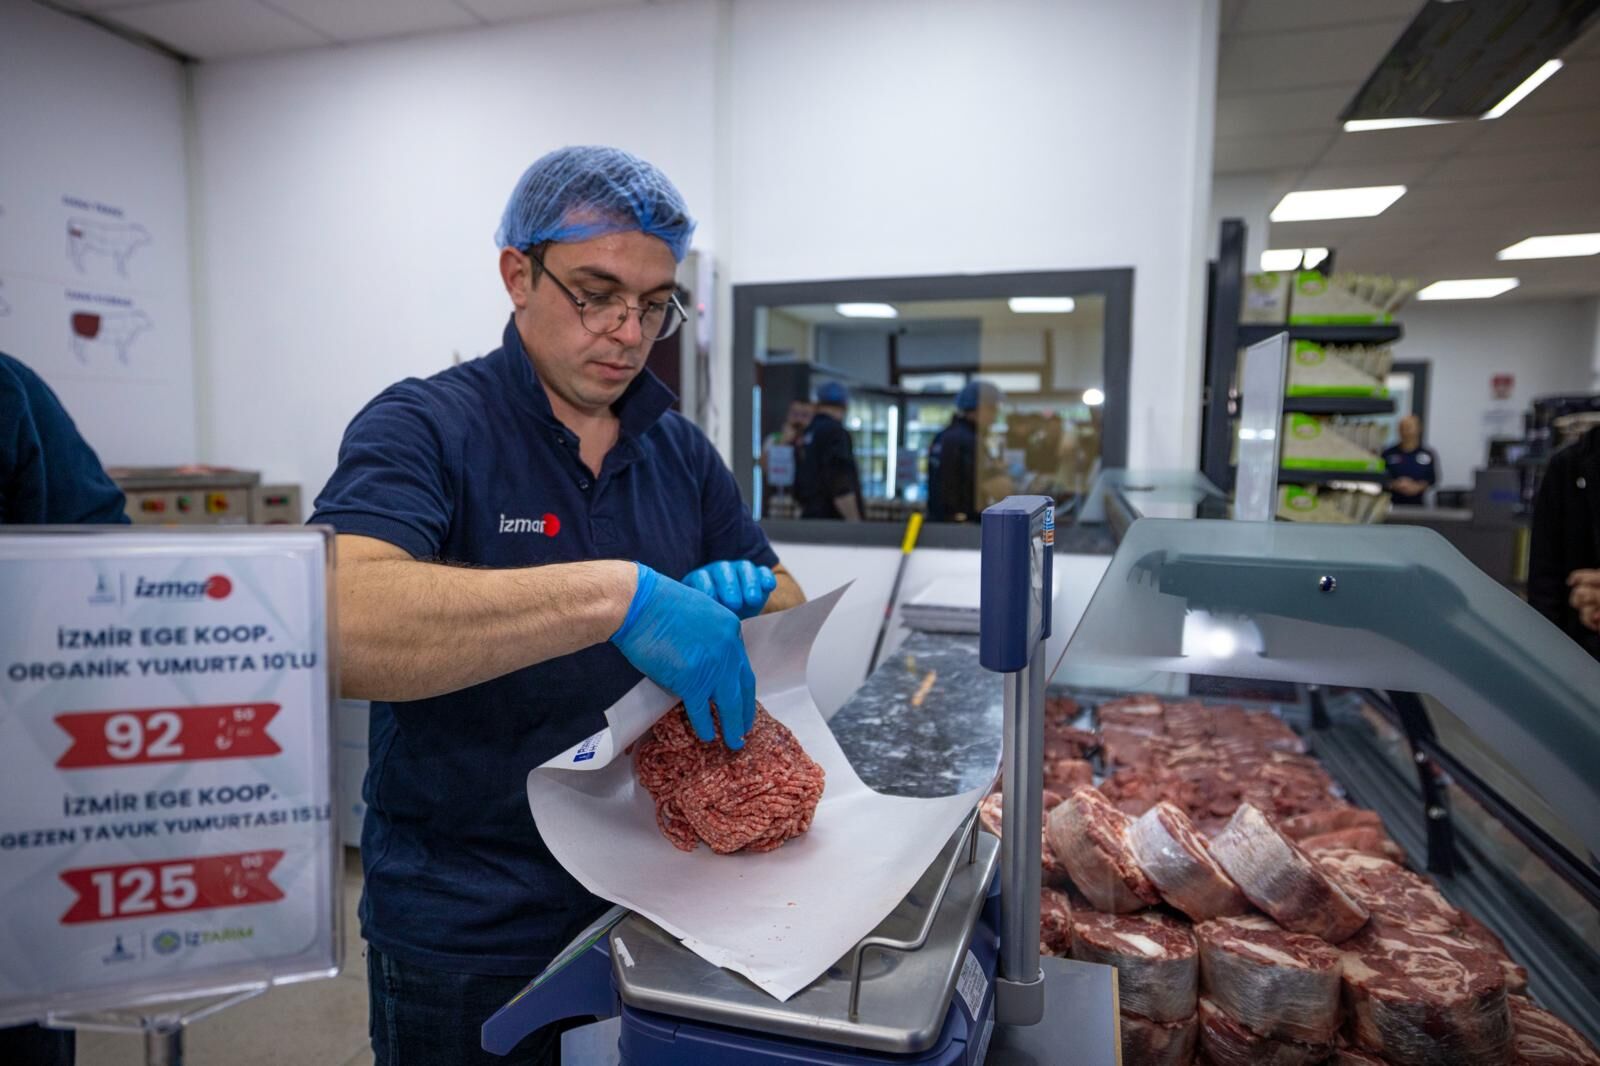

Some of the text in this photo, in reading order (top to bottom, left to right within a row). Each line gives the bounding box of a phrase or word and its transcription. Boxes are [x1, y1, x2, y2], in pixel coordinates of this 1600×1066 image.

[499, 513, 547, 534] izmar
[134, 575, 214, 598] izmar
[57, 623, 274, 650] İZMİR EGE KOOP.
[8, 657, 130, 682] ORGANİK
[138, 653, 256, 676] YUMURTA
[104, 711, 184, 759] 92
[63, 784, 277, 817] İZMİR EGE KOOP.
[0, 828, 75, 850] GEZEN
[83, 820, 158, 843] TAVUK
[164, 809, 287, 834] YUMURTASI
[91, 863, 198, 917] 125
